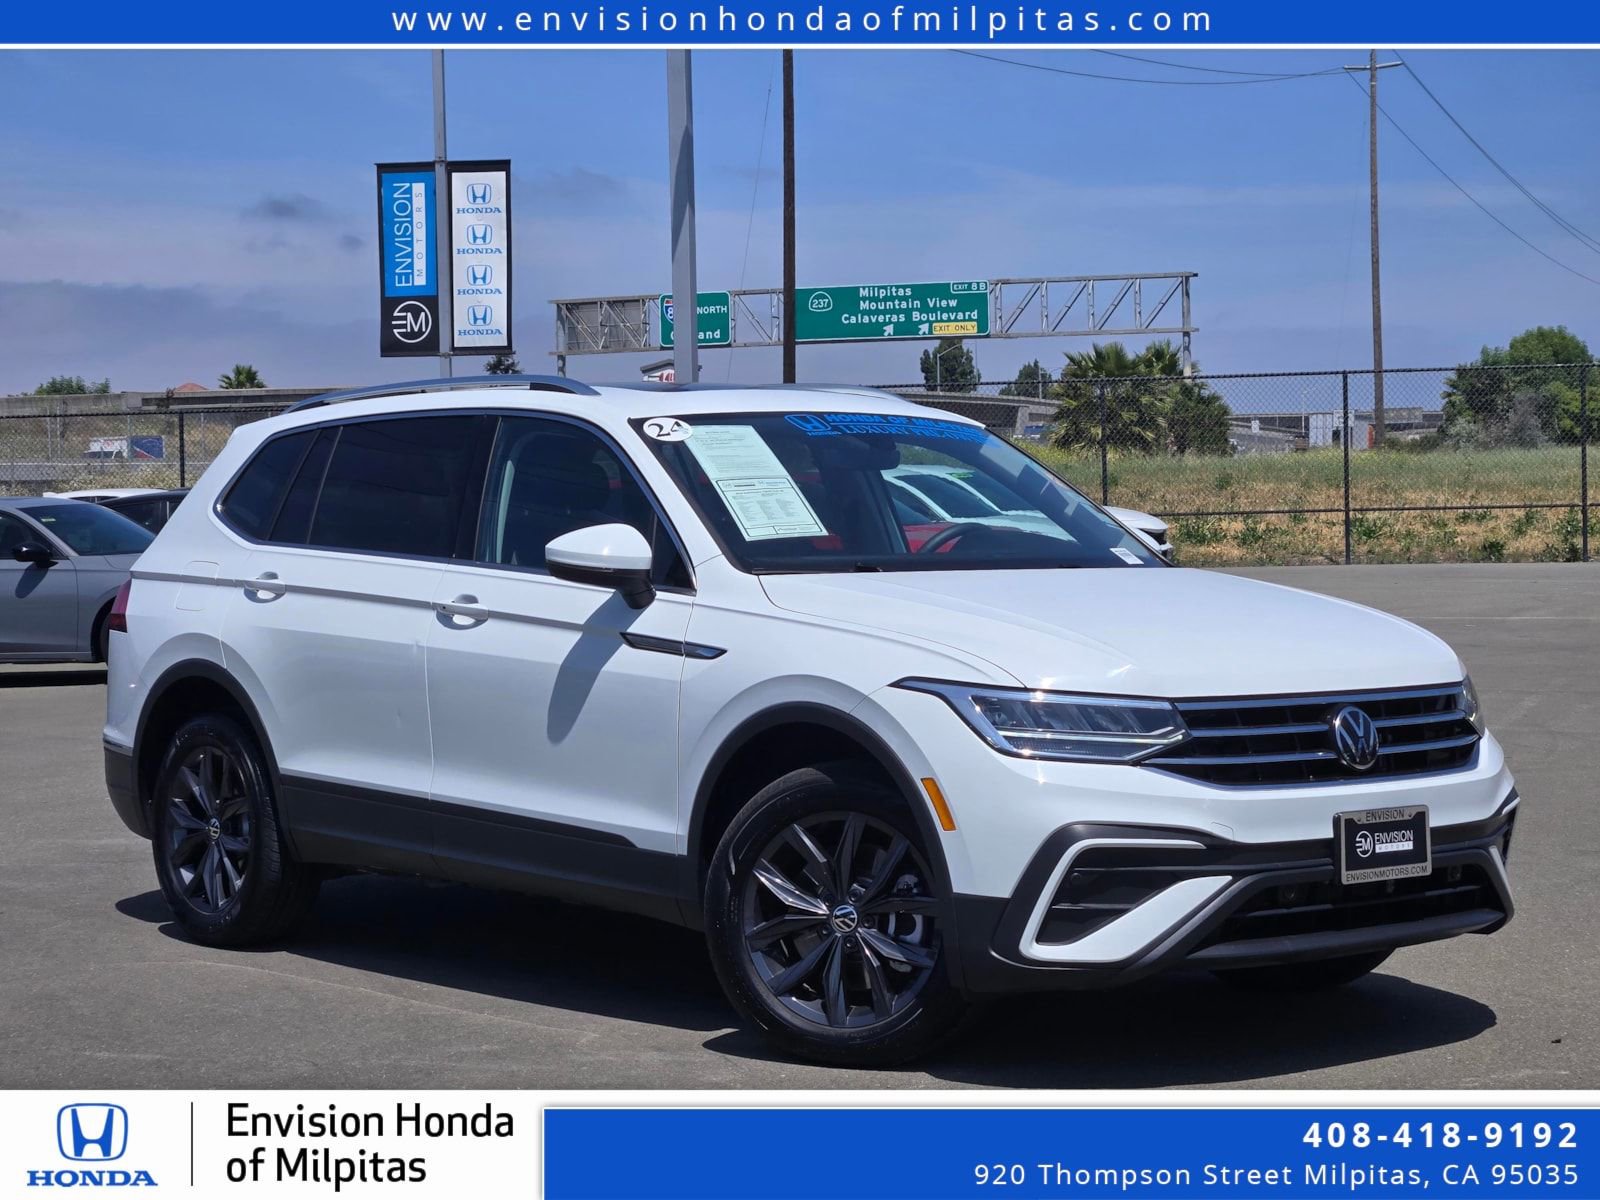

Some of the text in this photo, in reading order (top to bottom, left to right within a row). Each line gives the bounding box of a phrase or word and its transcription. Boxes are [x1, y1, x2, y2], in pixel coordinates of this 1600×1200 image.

[392, 182, 412, 287] ENVISION
[415, 192, 424, 277] MOTORS
[859, 286, 912, 298] Milpitas
[811, 298, 829, 308] 237
[860, 298, 958, 311] Mountain View
[696, 305, 728, 315] NORTH
[841, 309, 978, 324] Calaveras Boulevard
[954, 324, 977, 332] ONLY
[838, 424, 909, 435] LUXURY
[1365, 809, 1405, 822] ENVISION
[1374, 829, 1414, 844] ENVISION
